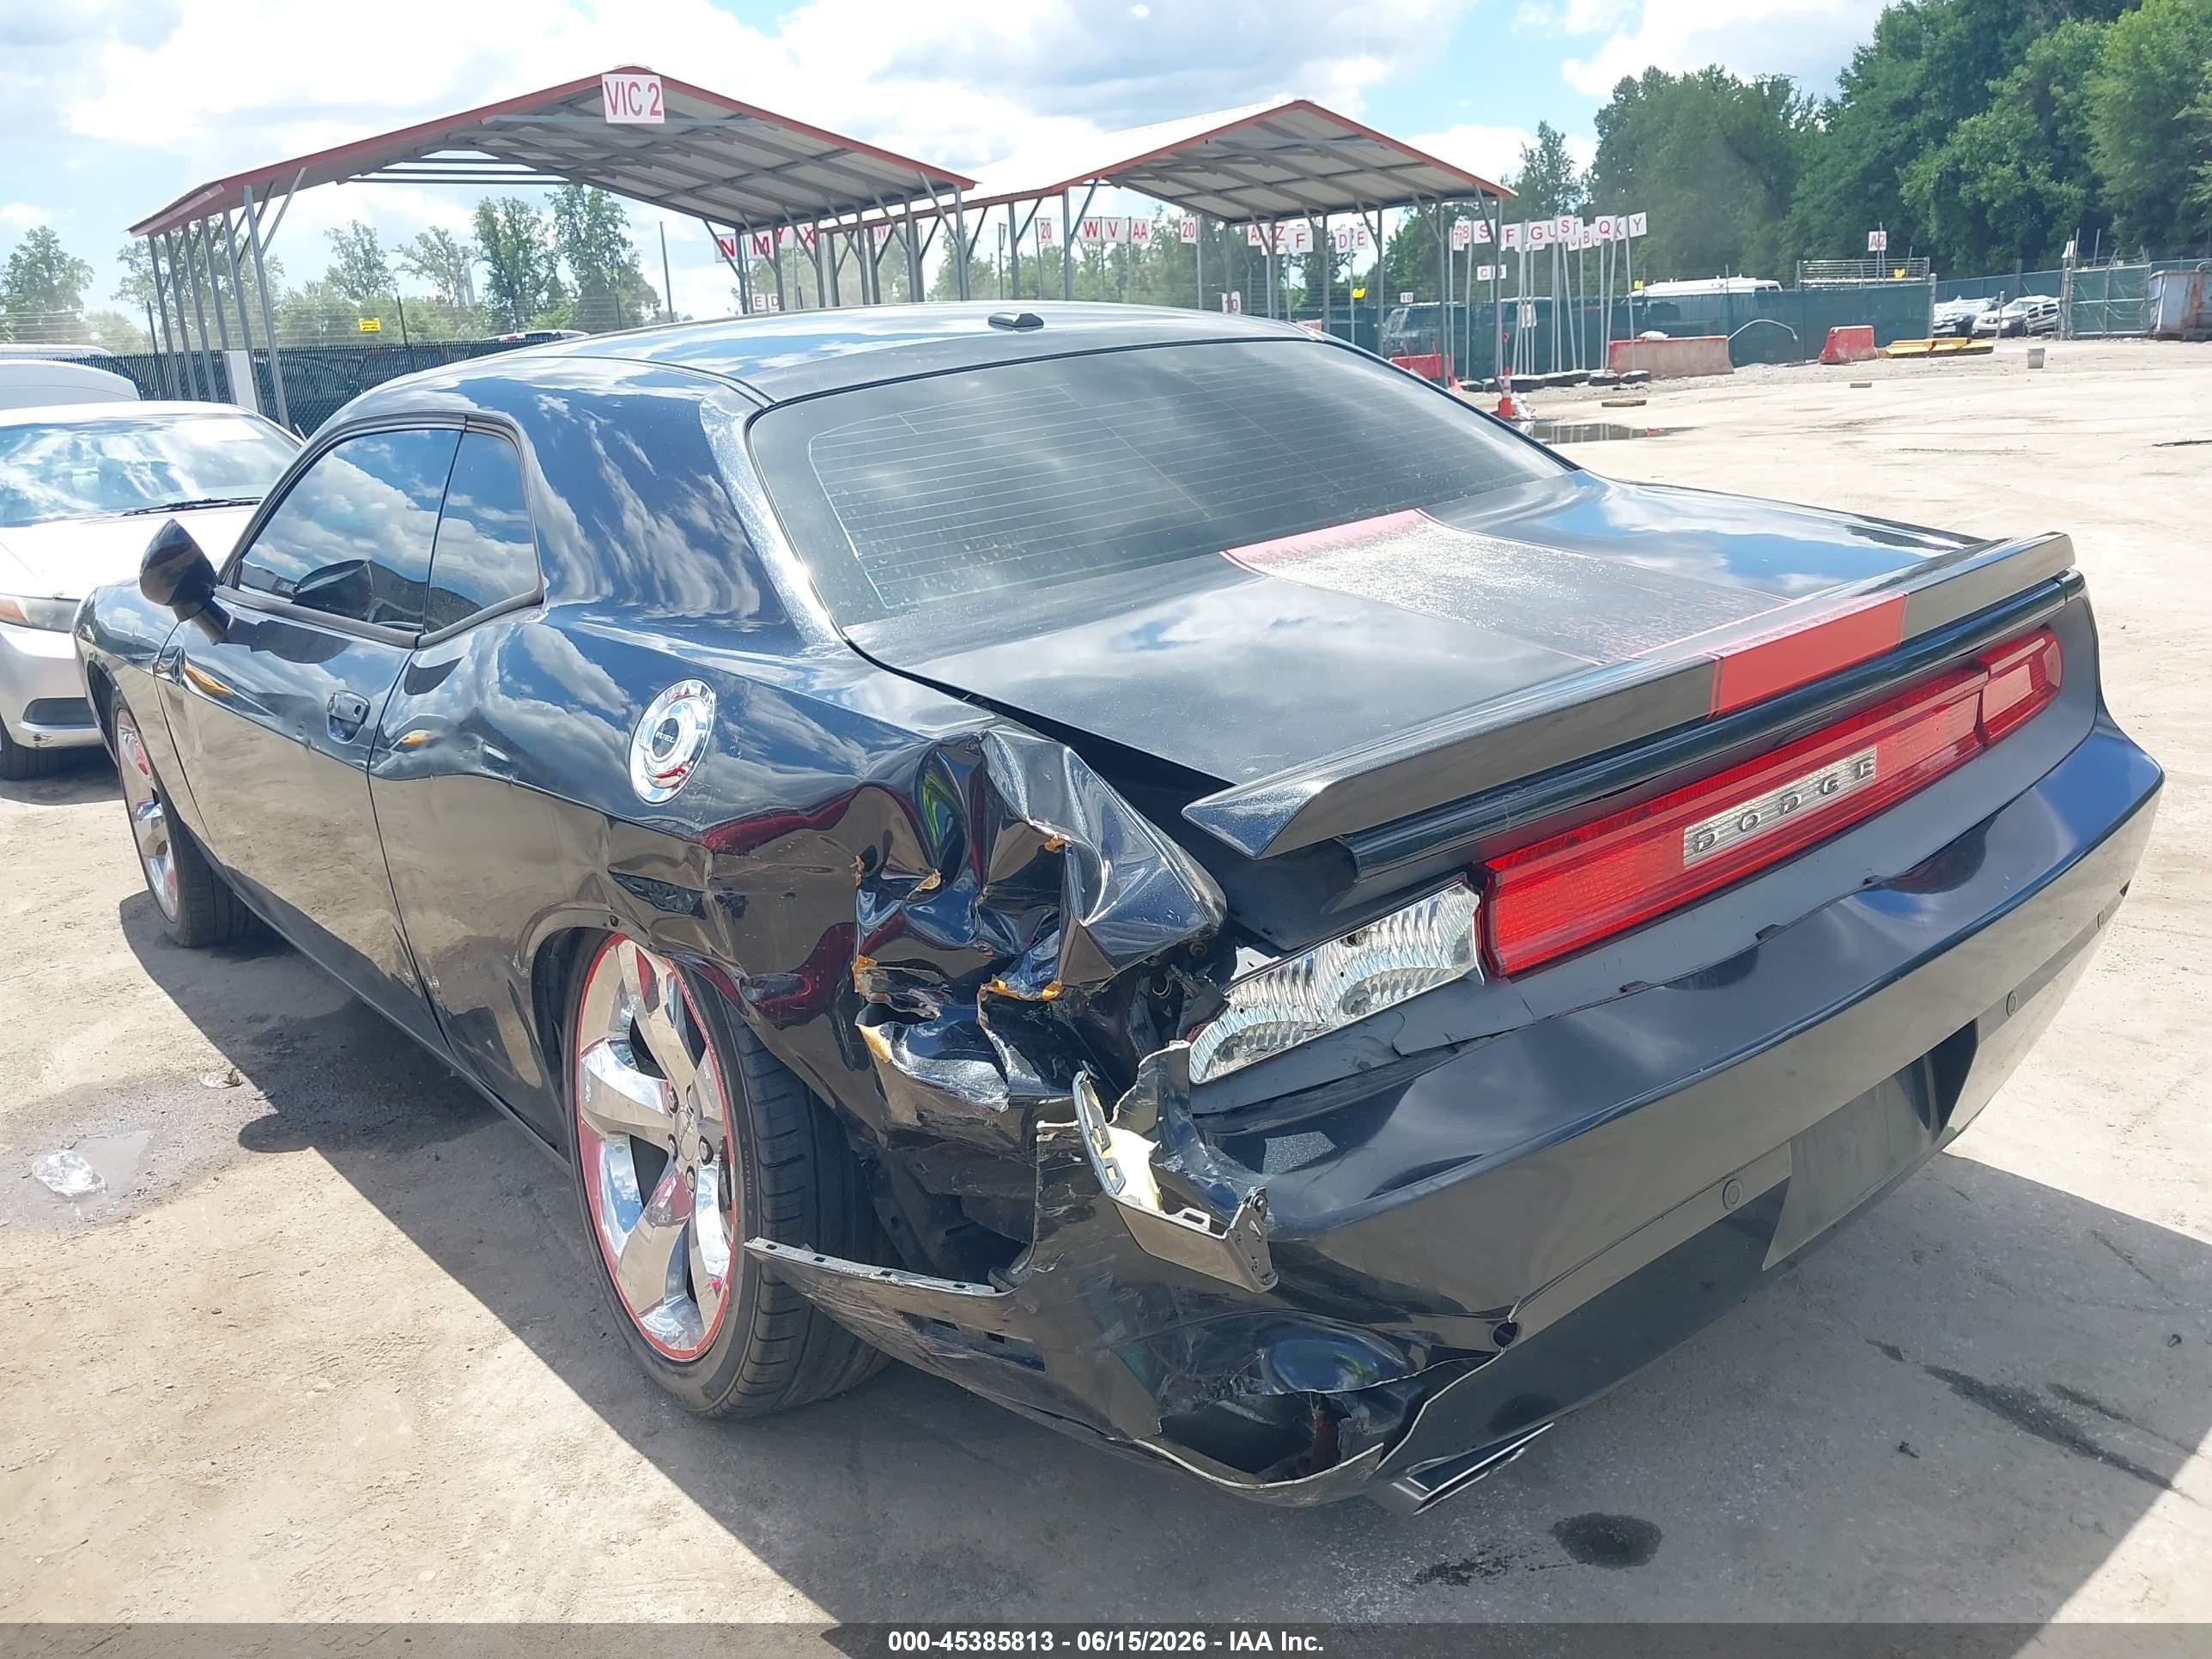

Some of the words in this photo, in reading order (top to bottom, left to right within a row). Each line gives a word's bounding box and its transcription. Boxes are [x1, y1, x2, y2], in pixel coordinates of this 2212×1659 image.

[605, 82, 642, 116] VIC
[648, 82, 662, 116] 2
[1040, 222, 1052, 240] 20
[1084, 221, 1098, 238] W
[1108, 221, 1118, 238] V
[1133, 222, 1148, 239] AA
[1182, 222, 1194, 238] 20
[1480, 224, 1490, 239] S
[1561, 219, 1570, 234] S
[1599, 221, 1611, 234] Q
[1633, 217, 1642, 232] Y
[1275, 226, 1285, 240] Z
[1296, 233, 1305, 248] F
[1358, 231, 1365, 246] E
[1506, 228, 1515, 243] F
[1531, 227, 1543, 240] G
[1583, 230, 1590, 244] B
[1870, 234, 1886, 247] A2
[720, 238, 735, 257] N
[752, 235, 770, 255] M
[1340, 234, 1347, 248] D
[755, 296, 763, 307] E
[655, 731, 676, 744] FUEL
[1692, 756, 1875, 854] DODGE
